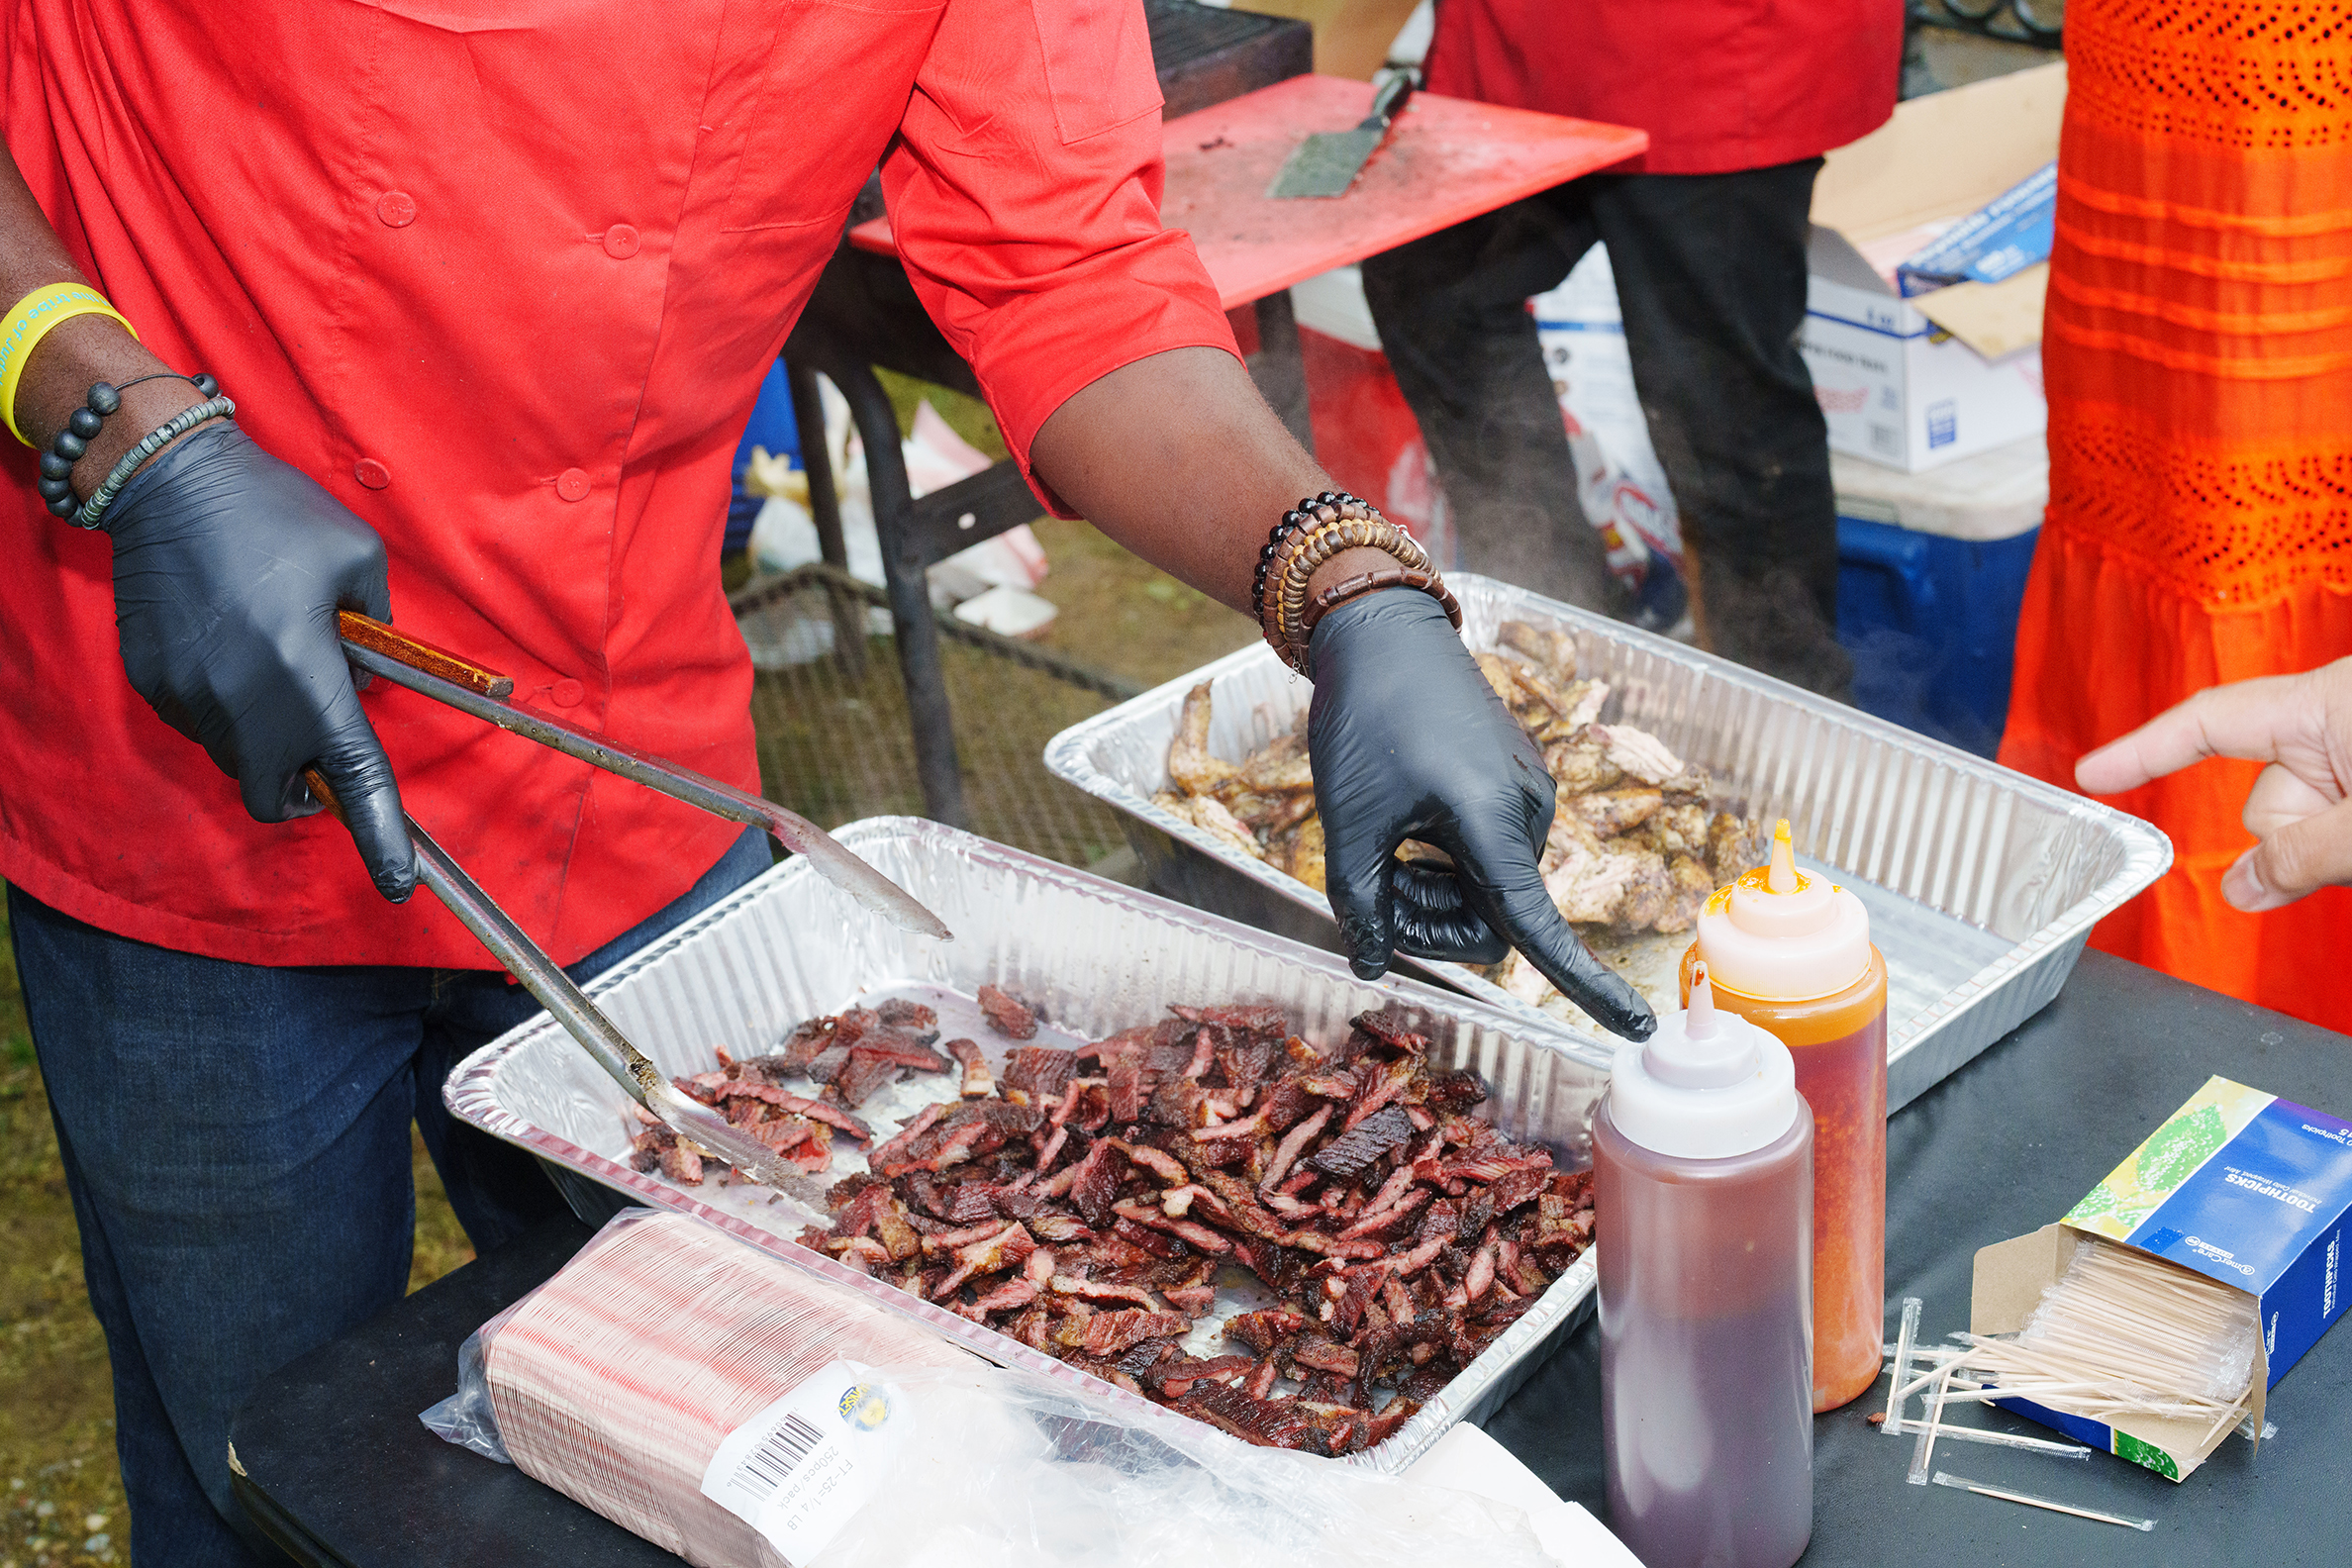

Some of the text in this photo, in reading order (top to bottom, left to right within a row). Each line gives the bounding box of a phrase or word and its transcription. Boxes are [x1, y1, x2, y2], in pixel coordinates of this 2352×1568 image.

[28, 293, 70, 319] tribe
[13, 320, 28, 342] of
[2302, 1124, 2346, 1144] Toothpicks
[2224, 1173, 2316, 1214] TOOTHPICKS
[2322, 1239, 2335, 1320] TOOTHPICKS
[777, 1445, 839, 1511] 250pcs/pack
[786, 1514, 803, 1531] LB
